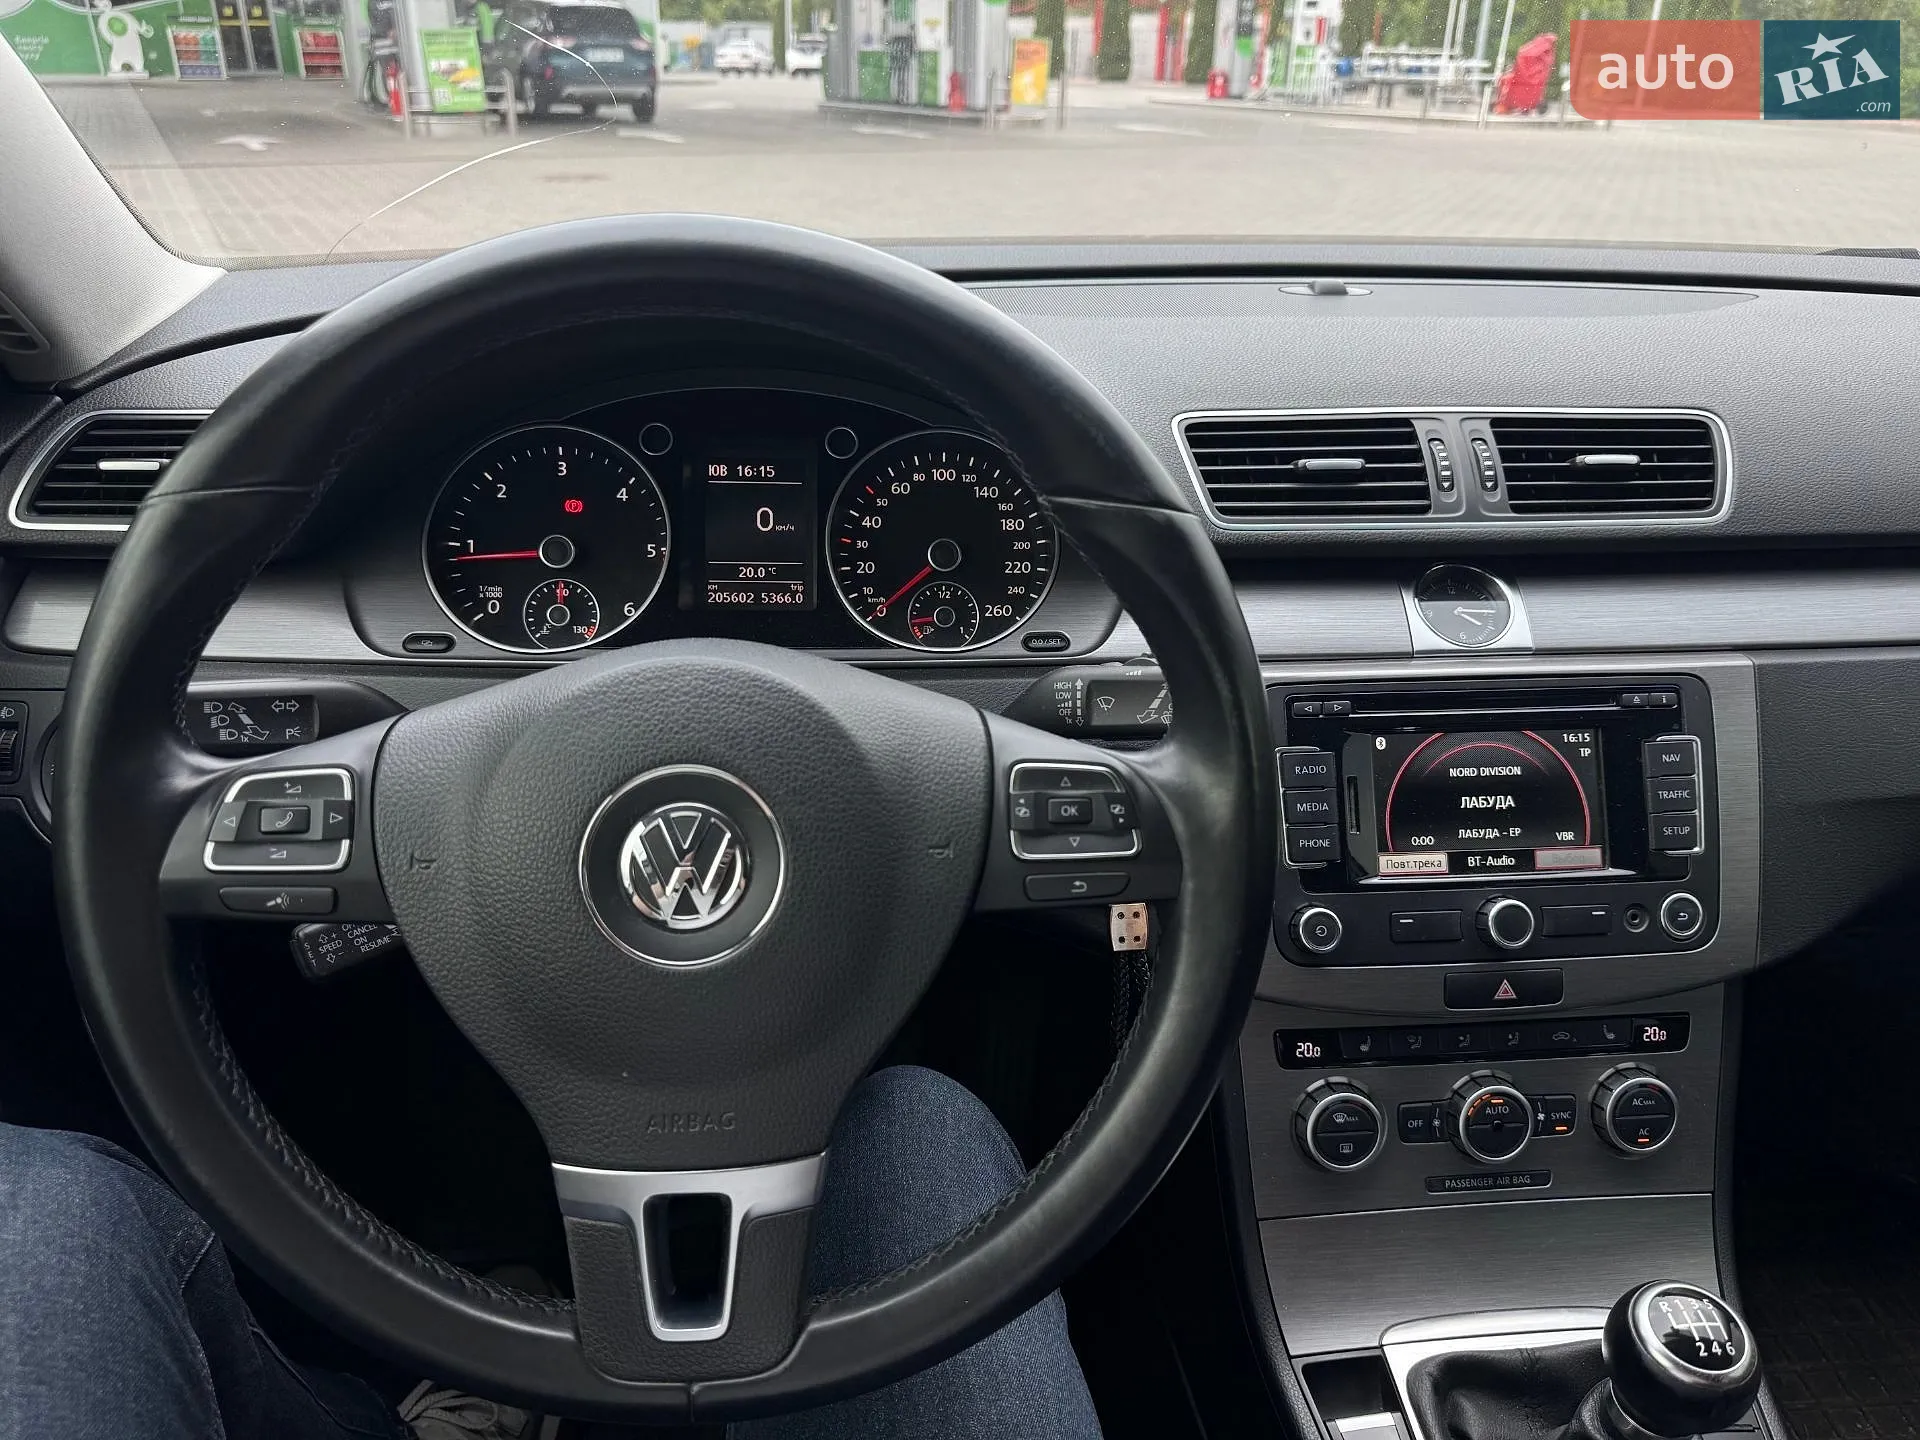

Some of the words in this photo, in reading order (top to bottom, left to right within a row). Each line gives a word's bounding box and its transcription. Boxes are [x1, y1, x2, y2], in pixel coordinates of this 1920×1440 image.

[557, 461, 567, 476] 3
[737, 465, 775, 478] 16:15
[913, 473, 925, 482] 80
[931, 469, 956, 481] 100
[961, 474, 977, 483] 120
[497, 484, 507, 498] 2
[891, 482, 911, 494] 60
[973, 486, 999, 498] 140
[616, 487, 628, 502] 4
[876, 498, 888, 506] 50
[997, 503, 1013, 511] 160
[756, 507, 774, 532] 0
[861, 516, 882, 529] 40
[1000, 518, 1025, 531] 180
[466, 539, 474, 553] 1
[856, 540, 868, 548] 30
[1013, 541, 1031, 550] 200
[647, 544, 656, 558] 5
[738, 566, 766, 578] 20.0
[856, 561, 875, 574] 20
[1004, 561, 1031, 574] 220
[790, 584, 804, 592] trip
[862, 587, 873, 595] 10
[1007, 586, 1025, 595] 240
[707, 592, 755, 604] 205602
[761, 592, 804, 604] 5366.0
[867, 596, 886, 604] km/h
[938, 591, 951, 599] 1/2
[488, 599, 500, 614] 0
[624, 602, 636, 617] 6
[876, 604, 887, 617] 0
[984, 605, 1013, 617] 260
[573, 625, 588, 634] 130
[1053, 681, 1072, 690] HIGH
[1055, 691, 1072, 700] LOW
[1059, 708, 1072, 716] OFF
[240, 734, 250, 743] 1x
[1562, 733, 1591, 744] 16:15
[1579, 747, 1591, 758] TP
[1662, 752, 1681, 764] NAV
[1294, 764, 1327, 777] RADIO
[1449, 767, 1477, 778] NORD
[1480, 766, 1521, 777] DIVISION
[1657, 788, 1690, 800] TRAFFIC
[1296, 801, 1329, 813] MEDIA
[1460, 795, 1515, 810] ЛАБУДА
[1061, 805, 1078, 816] OK
[1458, 828, 1500, 839] ЛАБУДА
[1509, 828, 1521, 838] EP
[1555, 831, 1575, 842] VBR
[1662, 825, 1690, 837] SETUP
[1298, 837, 1330, 849] PHONE
[1411, 836, 1434, 847] 0:00
[1386, 858, 1442, 871] Повт.трека
[1467, 855, 1515, 868] BT-Audio
[319, 939, 343, 955] SPEED
[354, 936, 367, 946] ON
[360, 935, 392, 953] RESUME
[1643, 1026, 1667, 1042] 20.0
[1295, 1042, 1321, 1058] 20.0
[1485, 1105, 1509, 1116] AUTO
[1550, 1111, 1572, 1121] SYNC
[646, 1111, 736, 1134] AIRBAG
[1407, 1119, 1424, 1129] OFF
[1638, 1127, 1650, 1137] AC
[1444, 1176, 1494, 1189] PASSENGER
[1496, 1176, 1511, 1187] AIR
[1512, 1174, 1531, 1186] BAG
[1659, 1302, 1672, 1313] R
[1674, 1300, 1684, 1310] 1
[1688, 1299, 1698, 1309] 3
[1703, 1299, 1713, 1309] 5
[1696, 1342, 1707, 1356] 2
[1712, 1342, 1721, 1355] 4
[1726, 1342, 1735, 1355] 6
